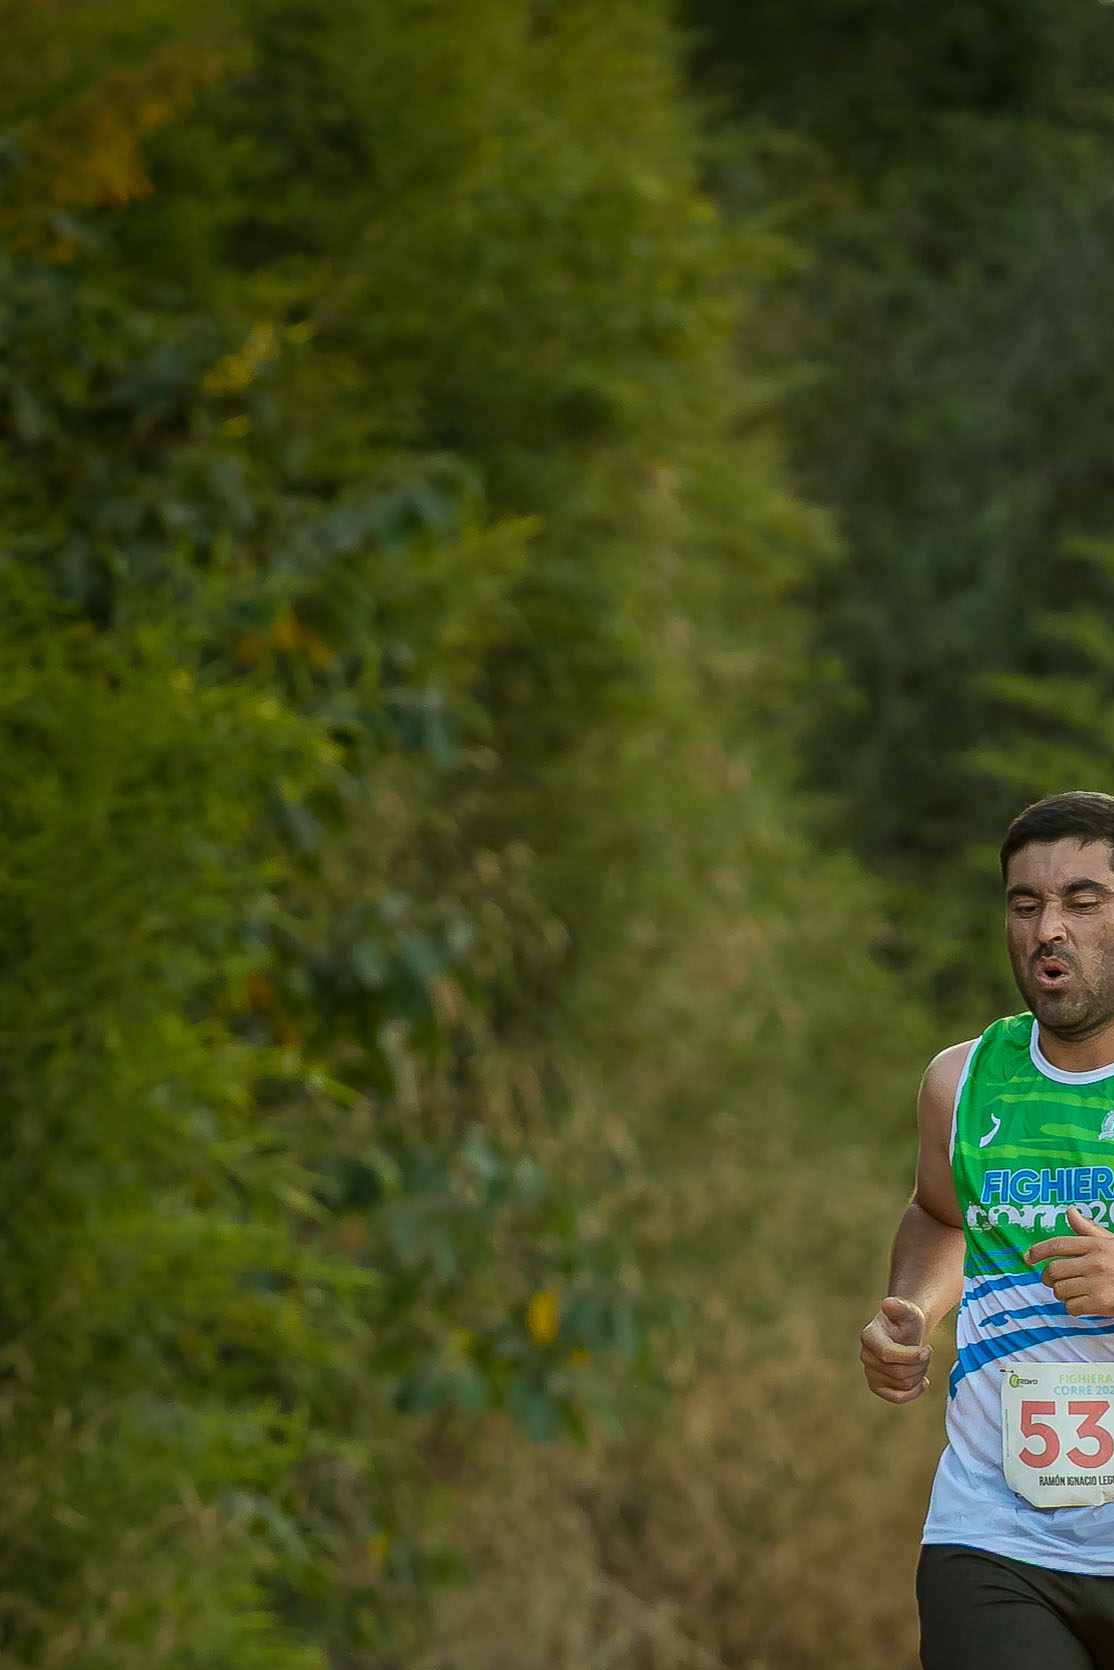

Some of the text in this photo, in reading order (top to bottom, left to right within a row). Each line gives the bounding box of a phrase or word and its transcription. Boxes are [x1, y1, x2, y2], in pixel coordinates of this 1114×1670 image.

[1058, 1373, 1113, 1385] FIGHIERA
[1053, 1384, 1093, 1396] CORRE
[1039, 1474, 1066, 1487] RAMÓN
[1067, 1475, 1097, 1487] IGNACIO
